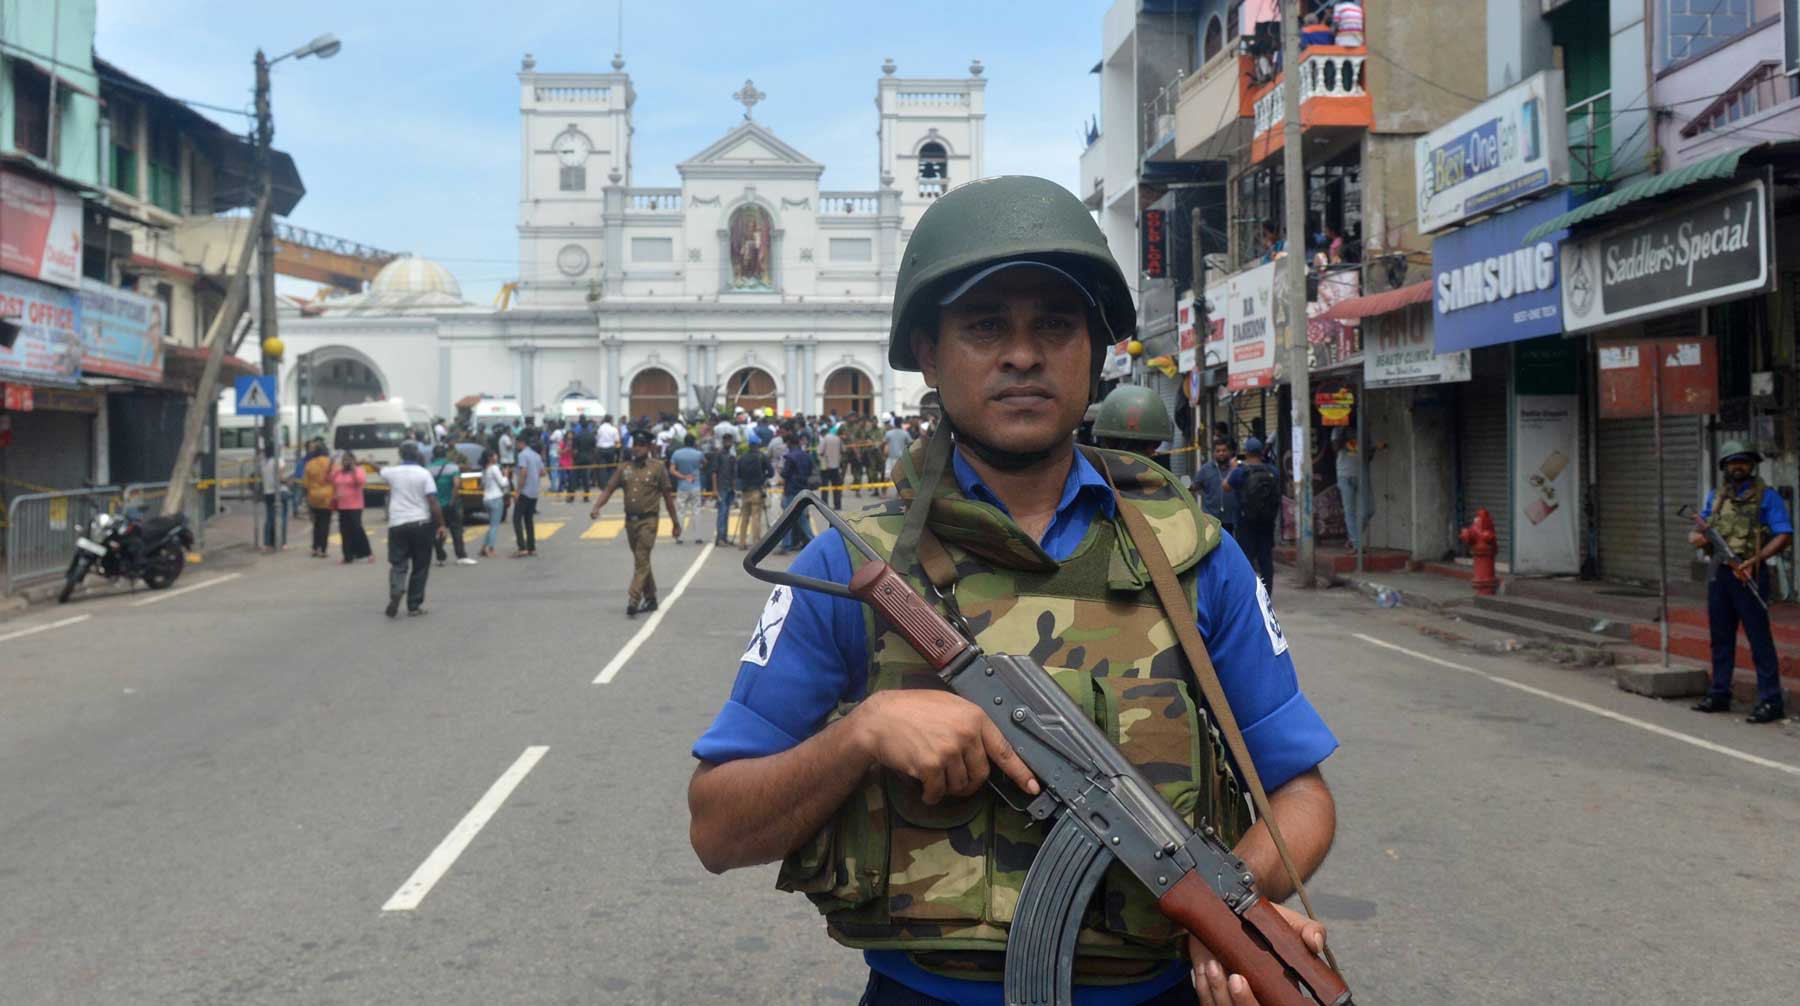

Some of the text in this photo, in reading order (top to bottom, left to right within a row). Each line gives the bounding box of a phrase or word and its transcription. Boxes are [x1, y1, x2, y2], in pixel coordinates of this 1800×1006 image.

[1605, 201, 1753, 287] Saddler's Special
[1438, 242, 1554, 314] SAMSUNG
[29, 301, 74, 330] OFFICE
[1232, 317, 1267, 343] FASHION
[1375, 353, 1404, 368] BEAUTY
[1404, 350, 1429, 364] CLINIC
